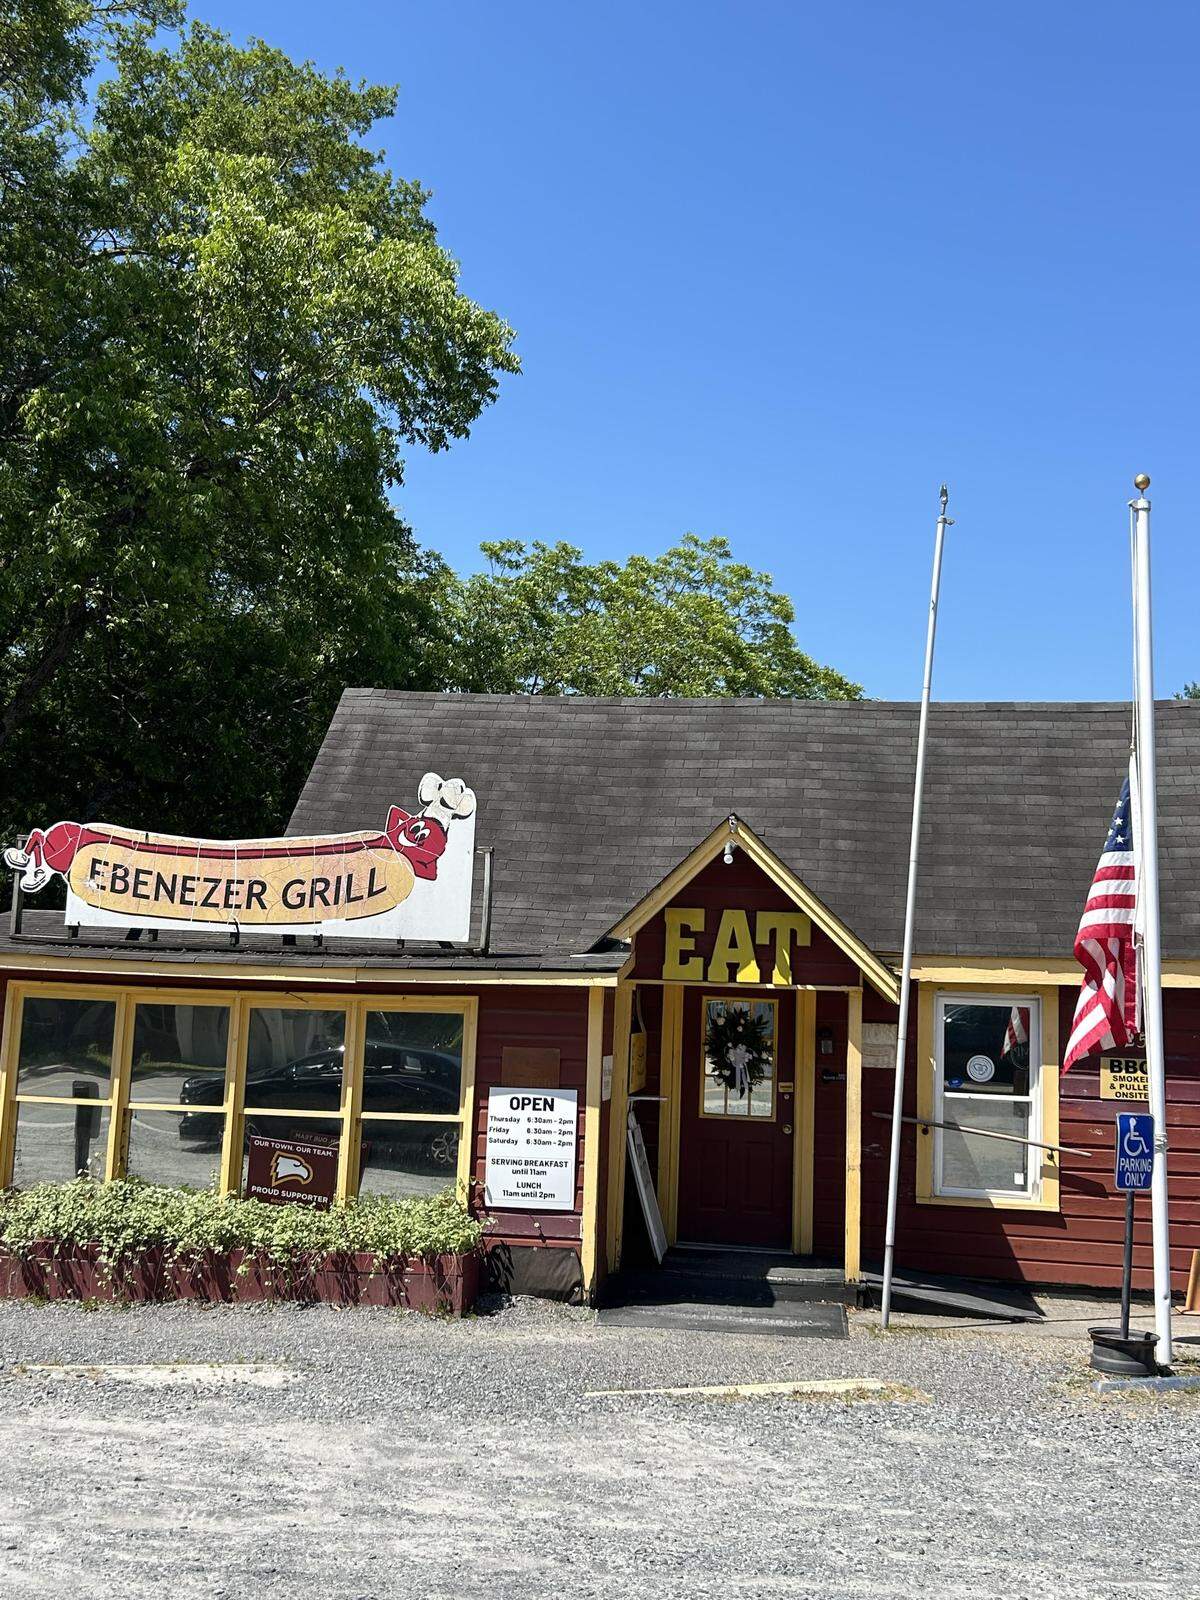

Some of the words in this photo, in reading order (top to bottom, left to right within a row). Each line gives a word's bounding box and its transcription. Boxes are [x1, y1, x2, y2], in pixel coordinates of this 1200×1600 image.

[89, 857, 268, 910] EBENEZER
[281, 867, 388, 909] GRILL
[662, 907, 812, 986] EAT
[1119, 1083, 1149, 1091] PULLE
[509, 1096, 555, 1111] OPEN
[490, 1116, 520, 1124] Thursday
[488, 1127, 509, 1135] Friday
[254, 1139, 269, 1147] OUR
[271, 1142, 294, 1151] TOWN.
[296, 1146, 312, 1154] OUR
[313, 1148, 334, 1157] TEAM.
[488, 1138, 518, 1146] Saturday
[491, 1158, 523, 1166] SERVING
[524, 1159, 568, 1168] BREAKFAST
[1119, 1157, 1152, 1173] PARKING
[530, 1168, 547, 1176] 11am
[1124, 1172, 1146, 1187] ONLY
[251, 1185, 280, 1196] PROUD
[281, 1190, 329, 1204] SUPPORTER
[502, 1189, 520, 1198] 11am
[521, 1190, 538, 1198] until
[539, 1191, 556, 1199] 2pm
